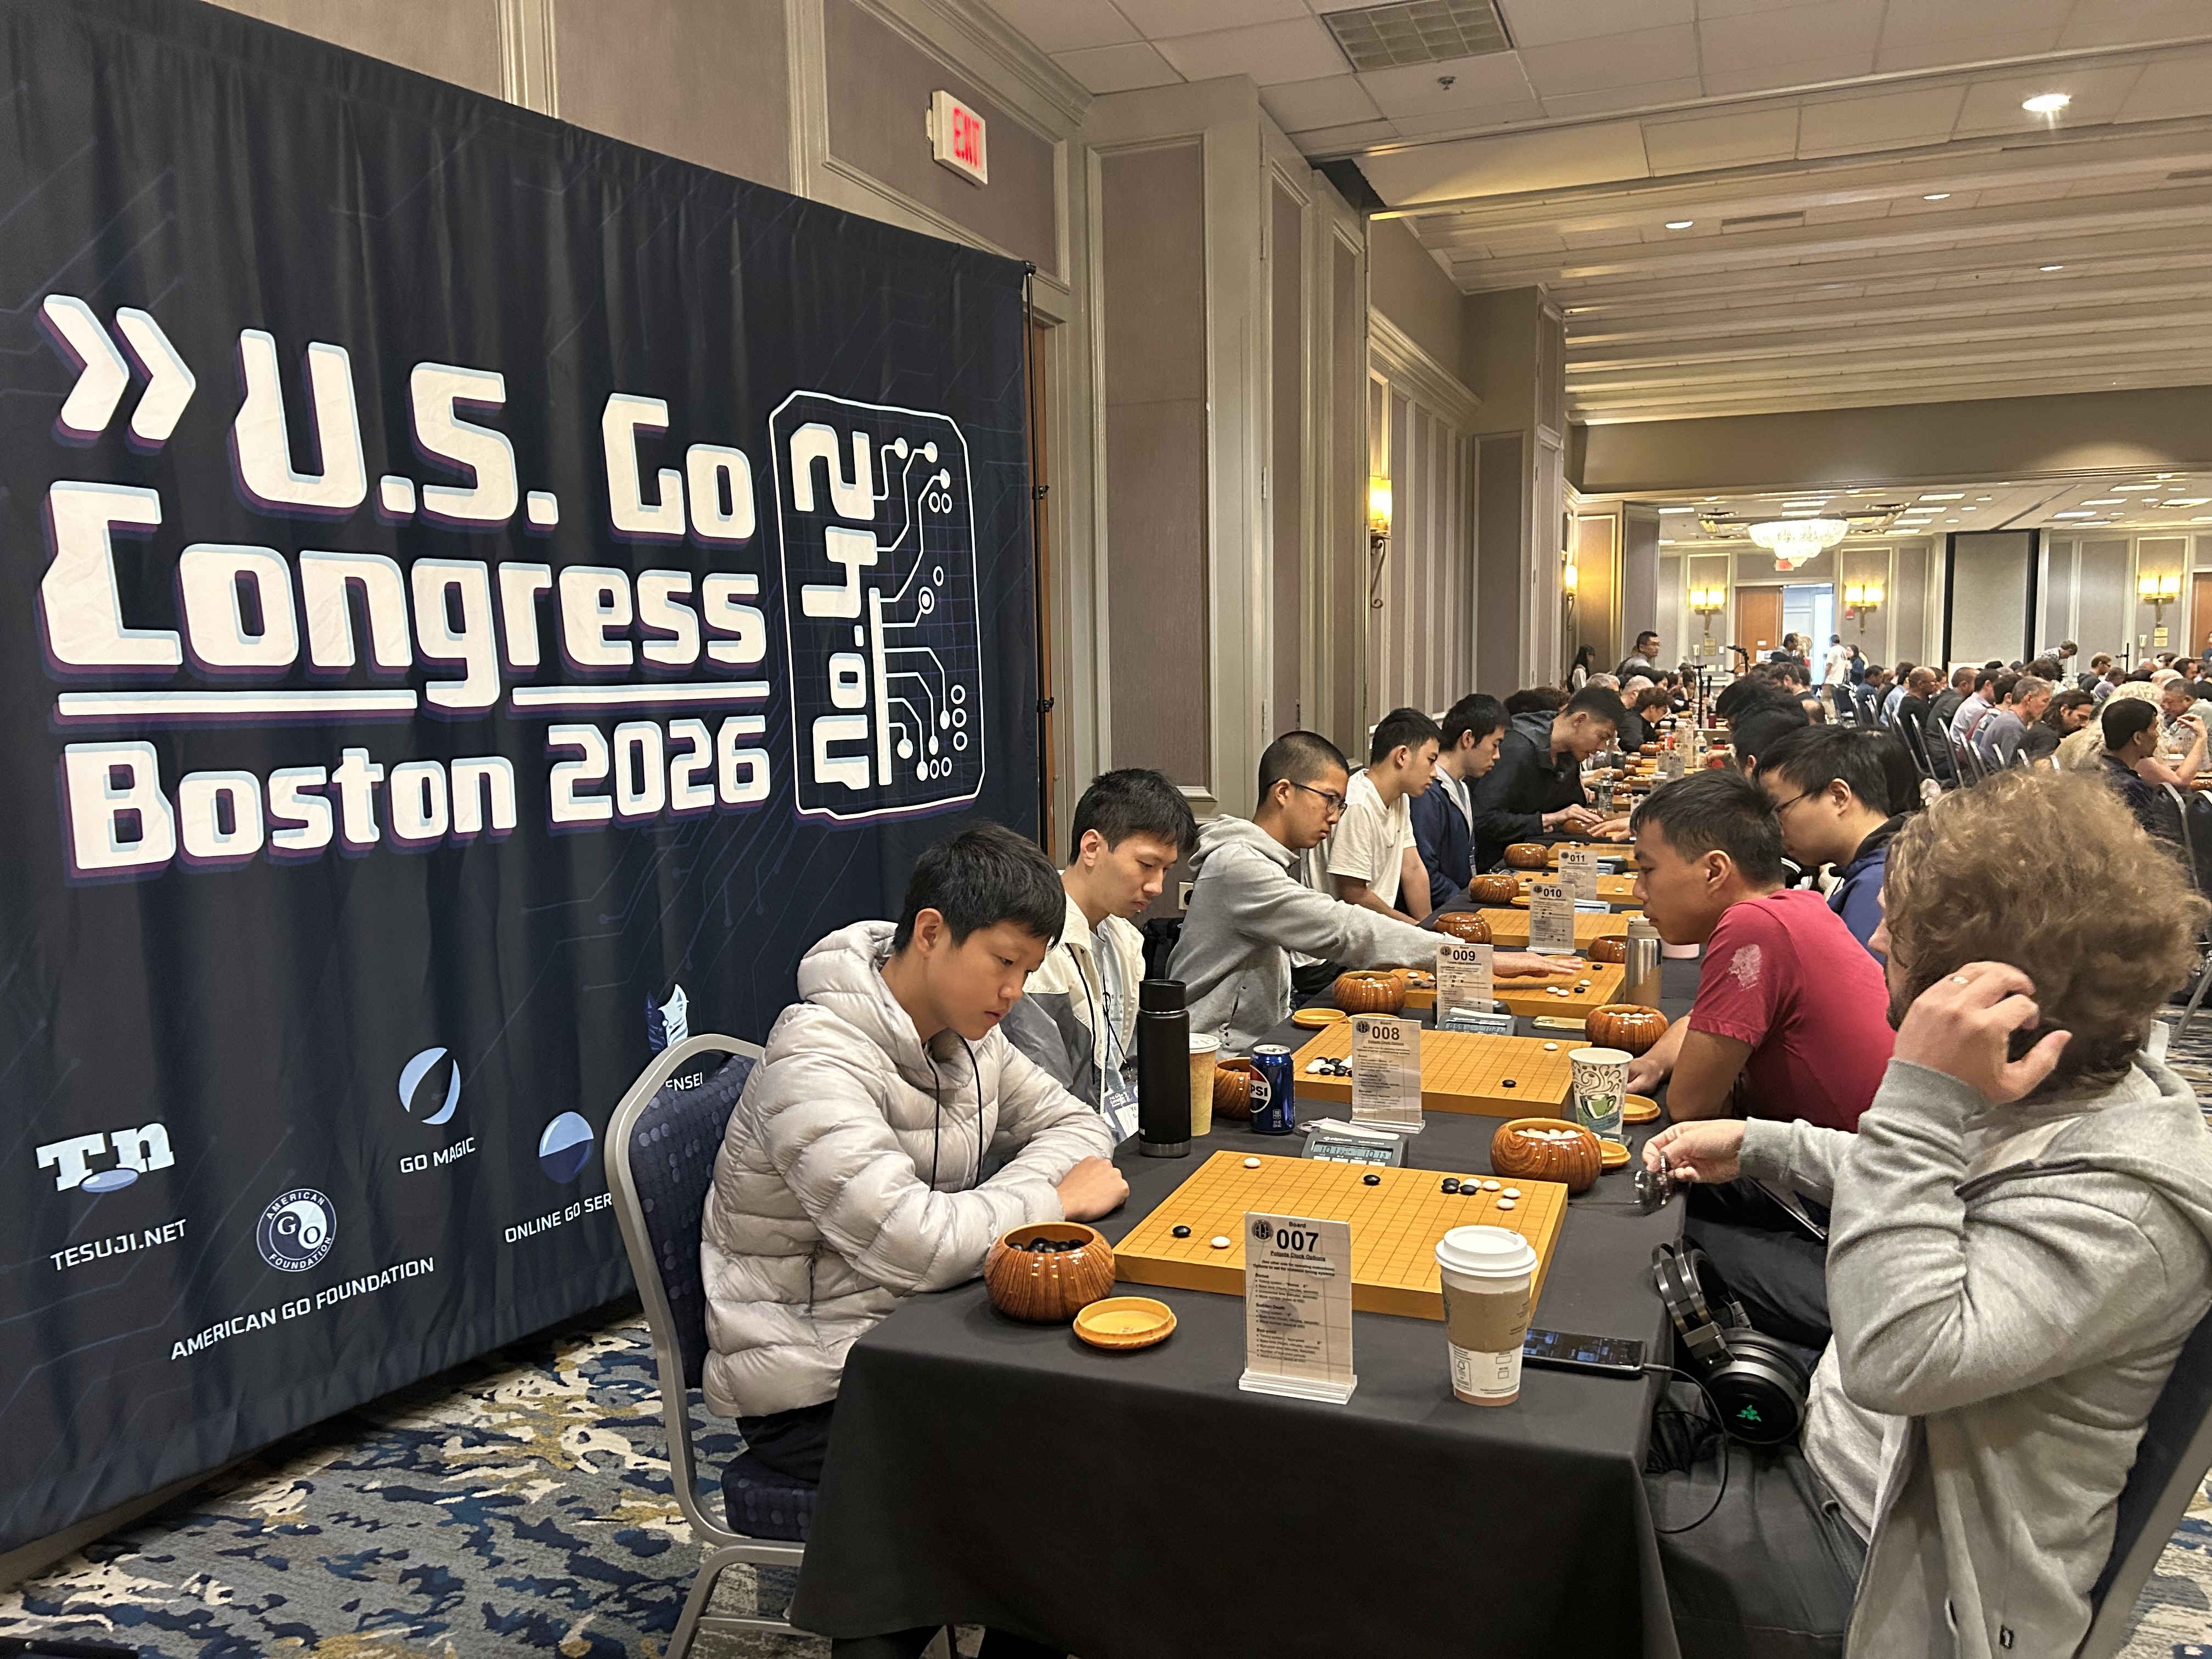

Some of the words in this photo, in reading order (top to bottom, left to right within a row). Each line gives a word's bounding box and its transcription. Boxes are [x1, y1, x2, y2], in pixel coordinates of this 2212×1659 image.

[953, 106, 981, 170] EXIT
[235, 329, 558, 525] U.S.
[602, 392, 755, 539] Go
[42, 481, 766, 708] Congress
[64, 741, 517, 870] Boston
[548, 715, 771, 822] 2026
[1543, 888, 1561, 898] 010
[1453, 950, 1476, 961] 009
[1372, 1026, 1400, 1040] 008
[400, 1154, 430, 1174] GO
[433, 1137, 476, 1167] MAGIC
[267, 1192, 325, 1220] AMERICAN
[504, 1211, 561, 1244] ONLINE
[564, 1203, 581, 1222] GO
[50, 1220, 187, 1271] TESUJI.NET
[269, 1237, 331, 1269] FOUNDATION
[1277, 1229, 1319, 1252] 007
[171, 1307, 277, 1361] AMERICAN
[281, 1297, 311, 1322] GO
[315, 1257, 435, 1309] FOUNDATION
